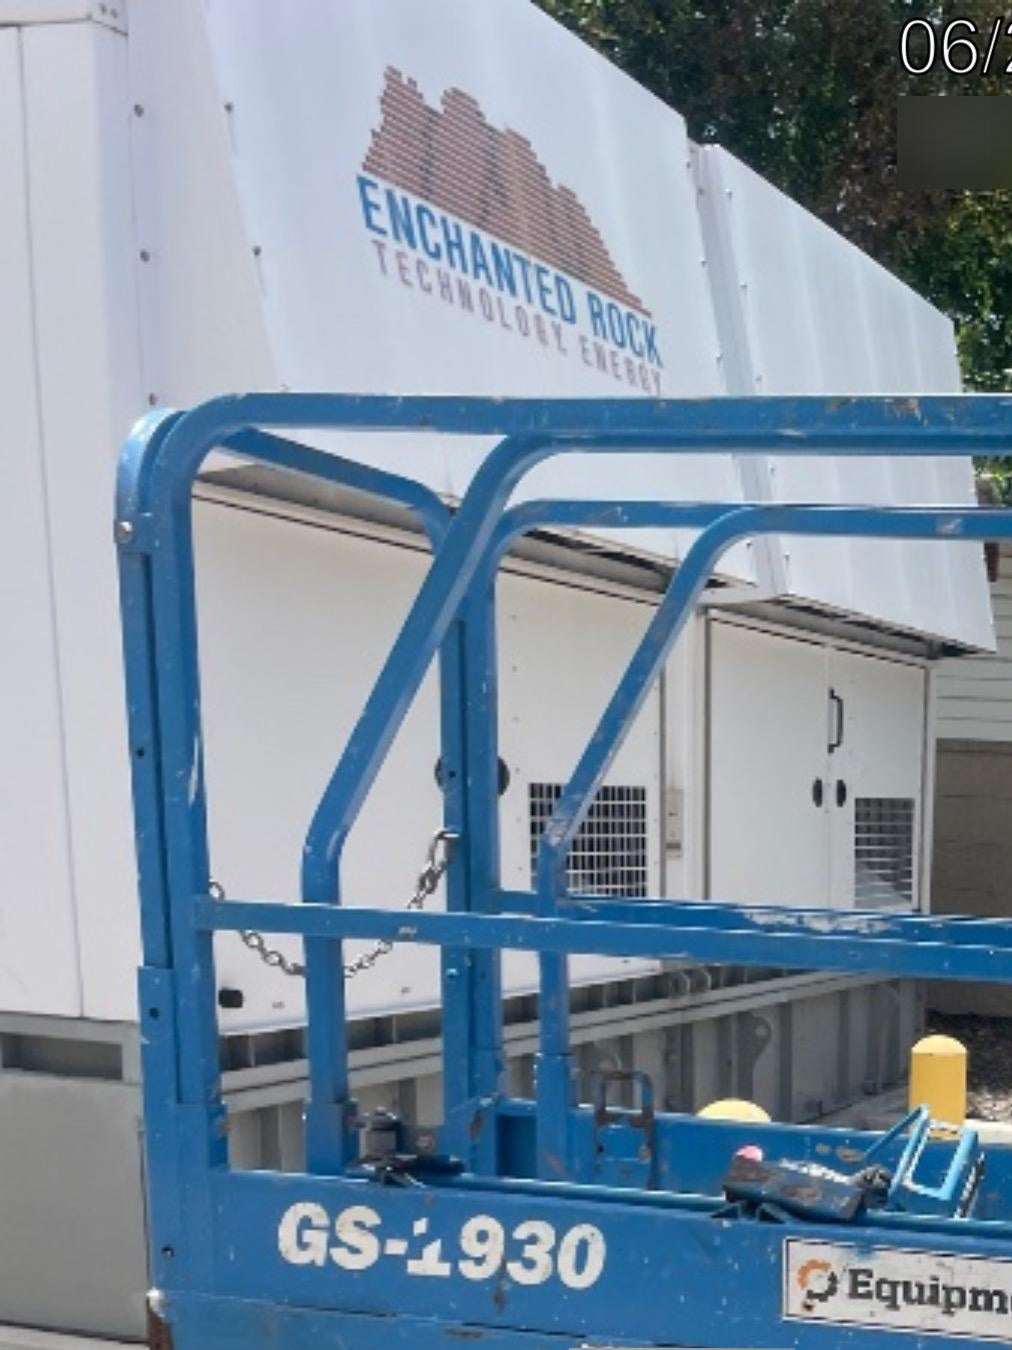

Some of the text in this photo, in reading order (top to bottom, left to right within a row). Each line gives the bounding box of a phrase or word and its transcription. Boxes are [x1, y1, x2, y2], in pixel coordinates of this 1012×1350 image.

[357, 174, 663, 369] ENCHANTED ROCK
[278, 1202, 606, 1289] GS-1930
